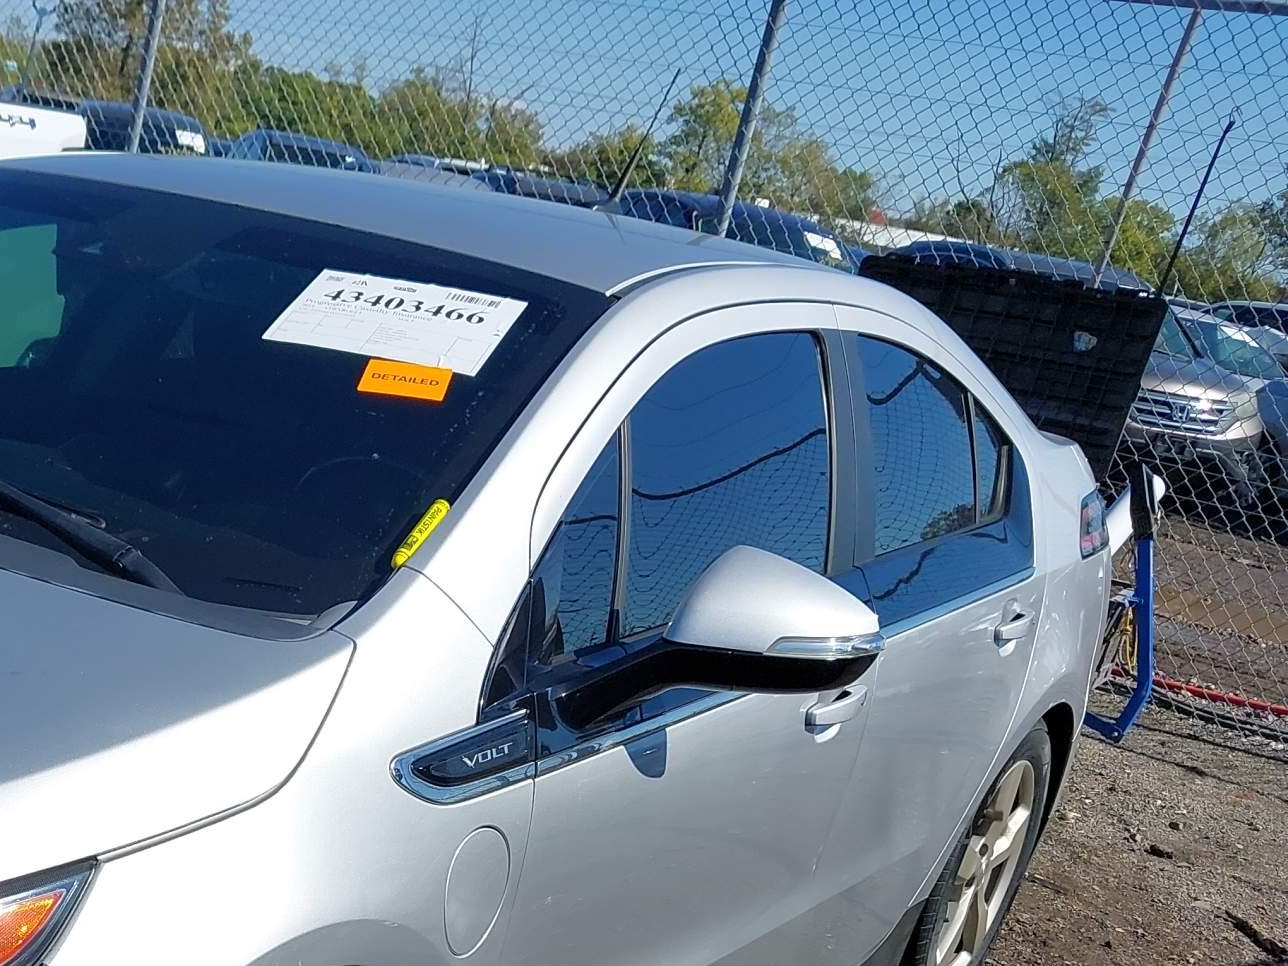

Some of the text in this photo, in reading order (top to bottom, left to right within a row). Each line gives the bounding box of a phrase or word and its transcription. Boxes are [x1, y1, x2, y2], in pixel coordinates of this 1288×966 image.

[323, 288, 488, 325] 43403466
[371, 372, 440, 387] DETAILED
[461, 741, 513, 768] VOLT
